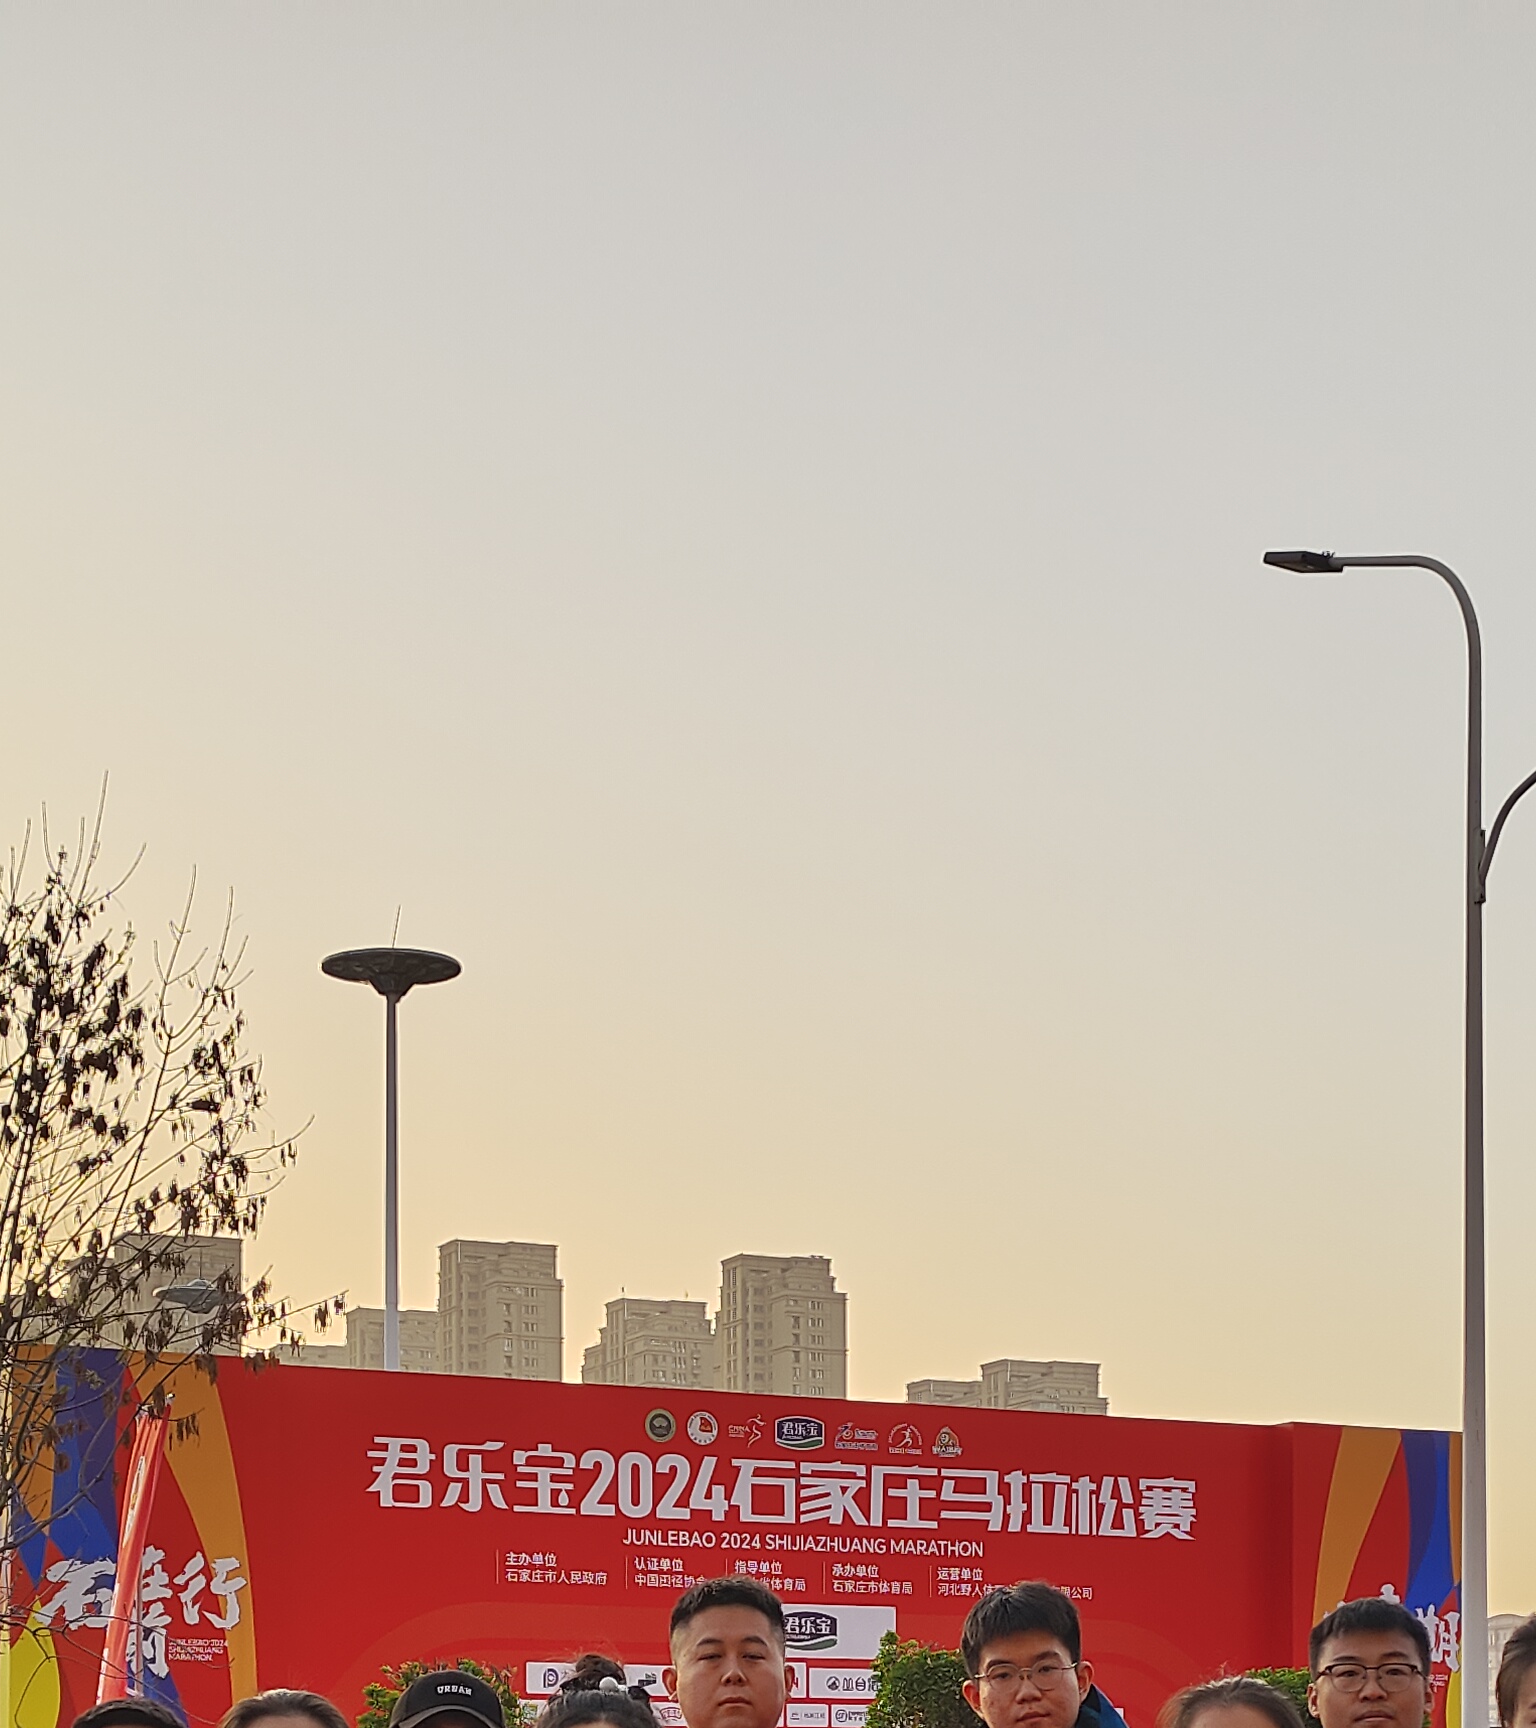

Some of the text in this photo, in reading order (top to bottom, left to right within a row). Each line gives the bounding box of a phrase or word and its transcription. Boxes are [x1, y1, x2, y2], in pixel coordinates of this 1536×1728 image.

[365, 1436, 1197, 1541] 君乐宝2024石家庄马拉松赛
[623, 1528, 984, 1558] JUNLEBAO 2024 SHIJIAZHUANG MARATHON
[504, 1552, 557, 1567] 主办单位
[634, 1557, 684, 1572] 认证单位
[734, 1560, 783, 1575] 指导单位
[832, 1563, 879, 1578] 承办单位
[936, 1567, 983, 1581] 运营单位
[505, 1570, 607, 1586] 石家庄市人民政府
[832, 1580, 913, 1596] 石家庄市体育局
